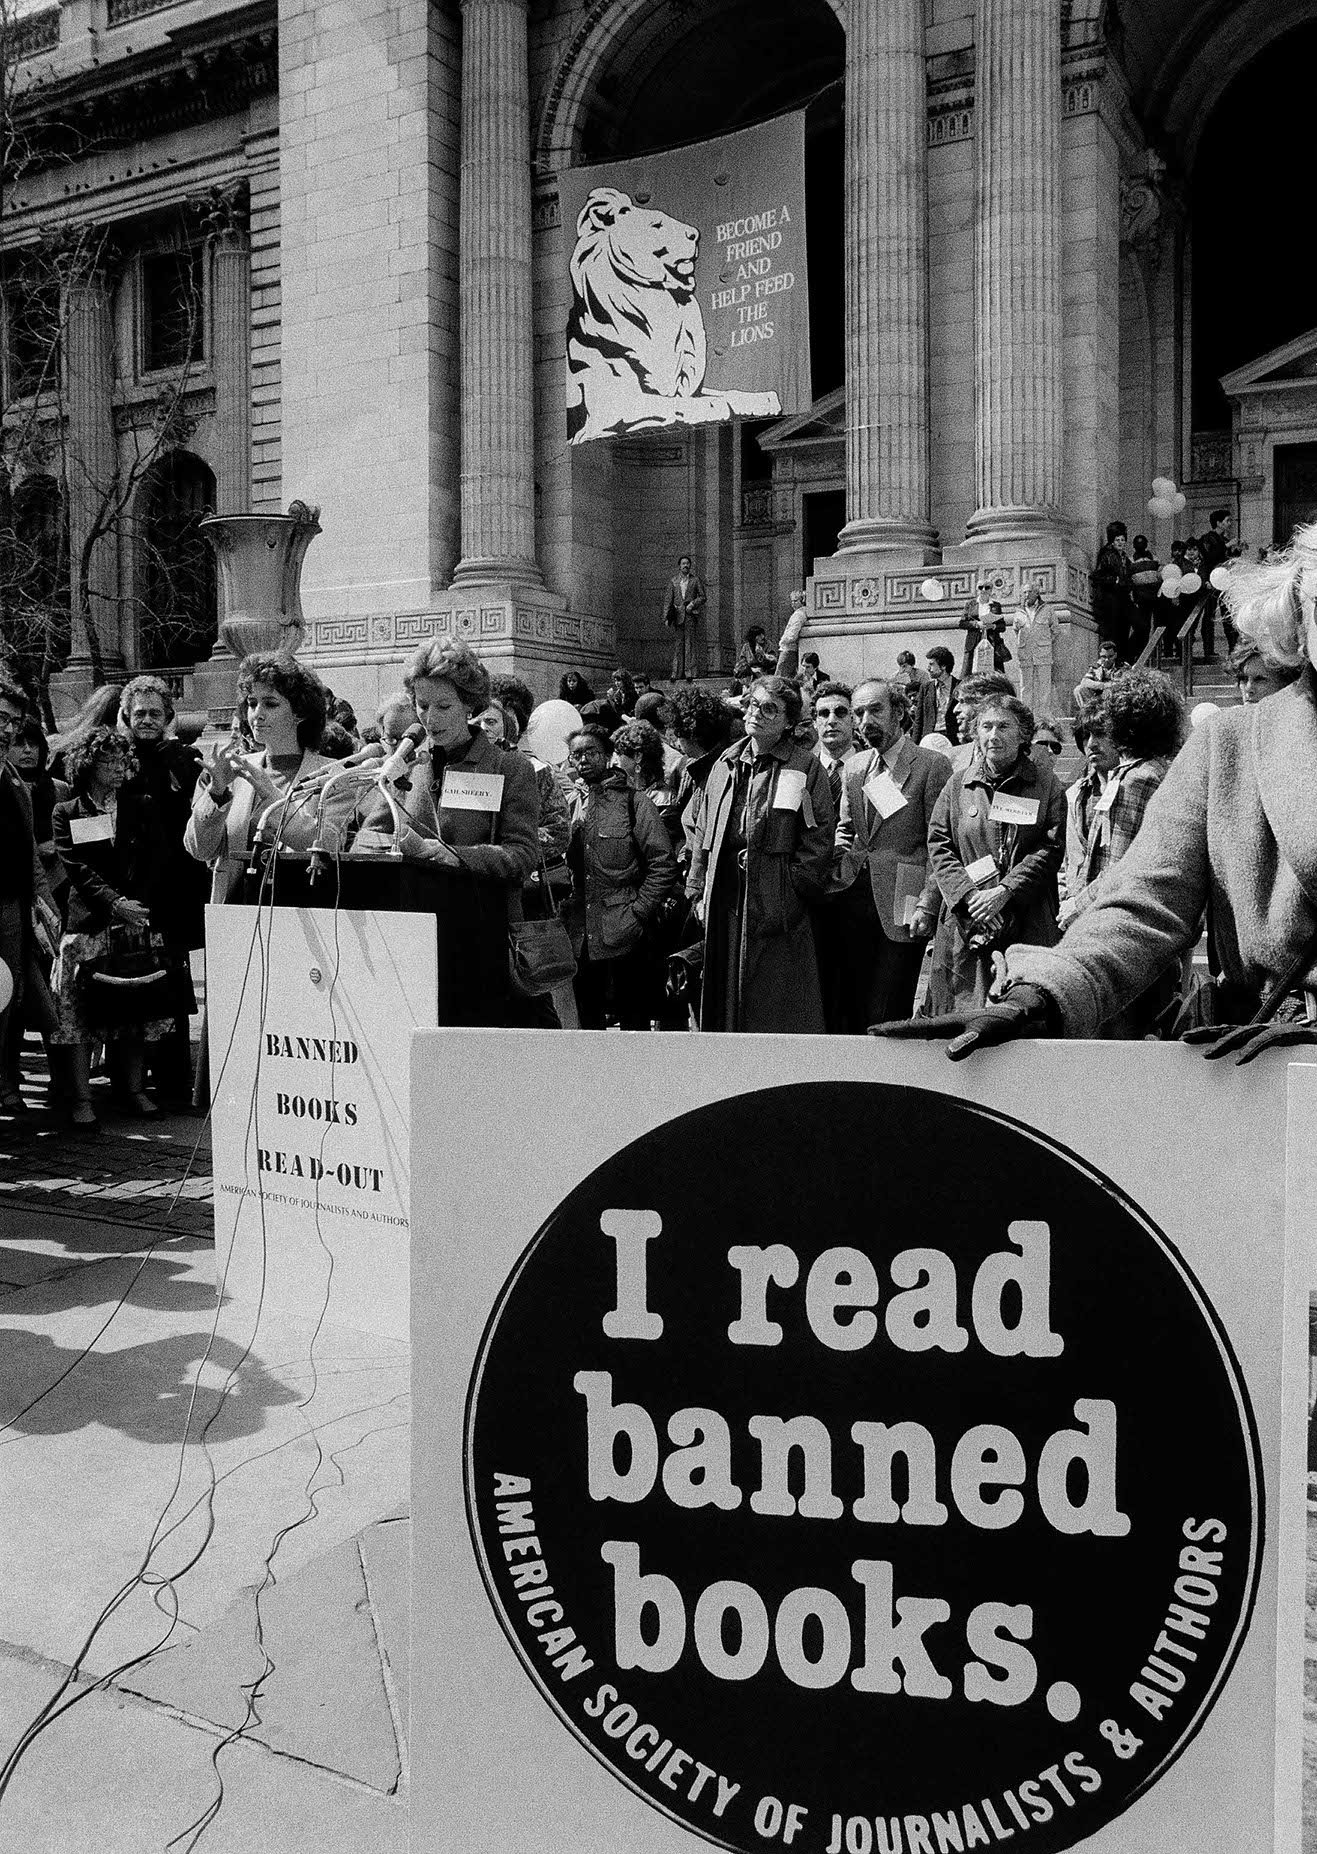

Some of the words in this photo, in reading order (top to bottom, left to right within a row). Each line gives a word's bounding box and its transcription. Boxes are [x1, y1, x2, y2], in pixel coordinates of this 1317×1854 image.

[716, 209, 777, 242] BECOME
[779, 205, 791, 224] A
[727, 231, 782, 262] FRIEND
[736, 257, 771, 282] AND
[711, 284, 751, 310] HELP
[755, 272, 795, 298] FEED
[737, 301, 768, 323] THE
[731, 321, 774, 347] LIONS
[266, 1034, 358, 1064] BANNED
[276, 1093, 358, 1126] BOOKS
[219, 1184, 257, 1198] AMERICAN
[289, 1197, 300, 1206] OF
[301, 1199, 350, 1216] JOURNALISTS
[351, 1208, 369, 1220] AND
[371, 1212, 409, 1228] AUTHORS
[600, 1208, 663, 1341] I
[728, 1220, 1065, 1358] read
[573, 1370, 1132, 1537] banned
[600, 1540, 1082, 1723] books.
[493, 1472, 595, 1682] AMERICAN
[583, 1683, 741, 1817] SOCIETY
[753, 1796, 809, 1845] OF
[826, 1751, 1102, 1854] JOURNALISTS
[1099, 1718, 1144, 1760] &
[1129, 1517, 1228, 1721] AUTHORS
